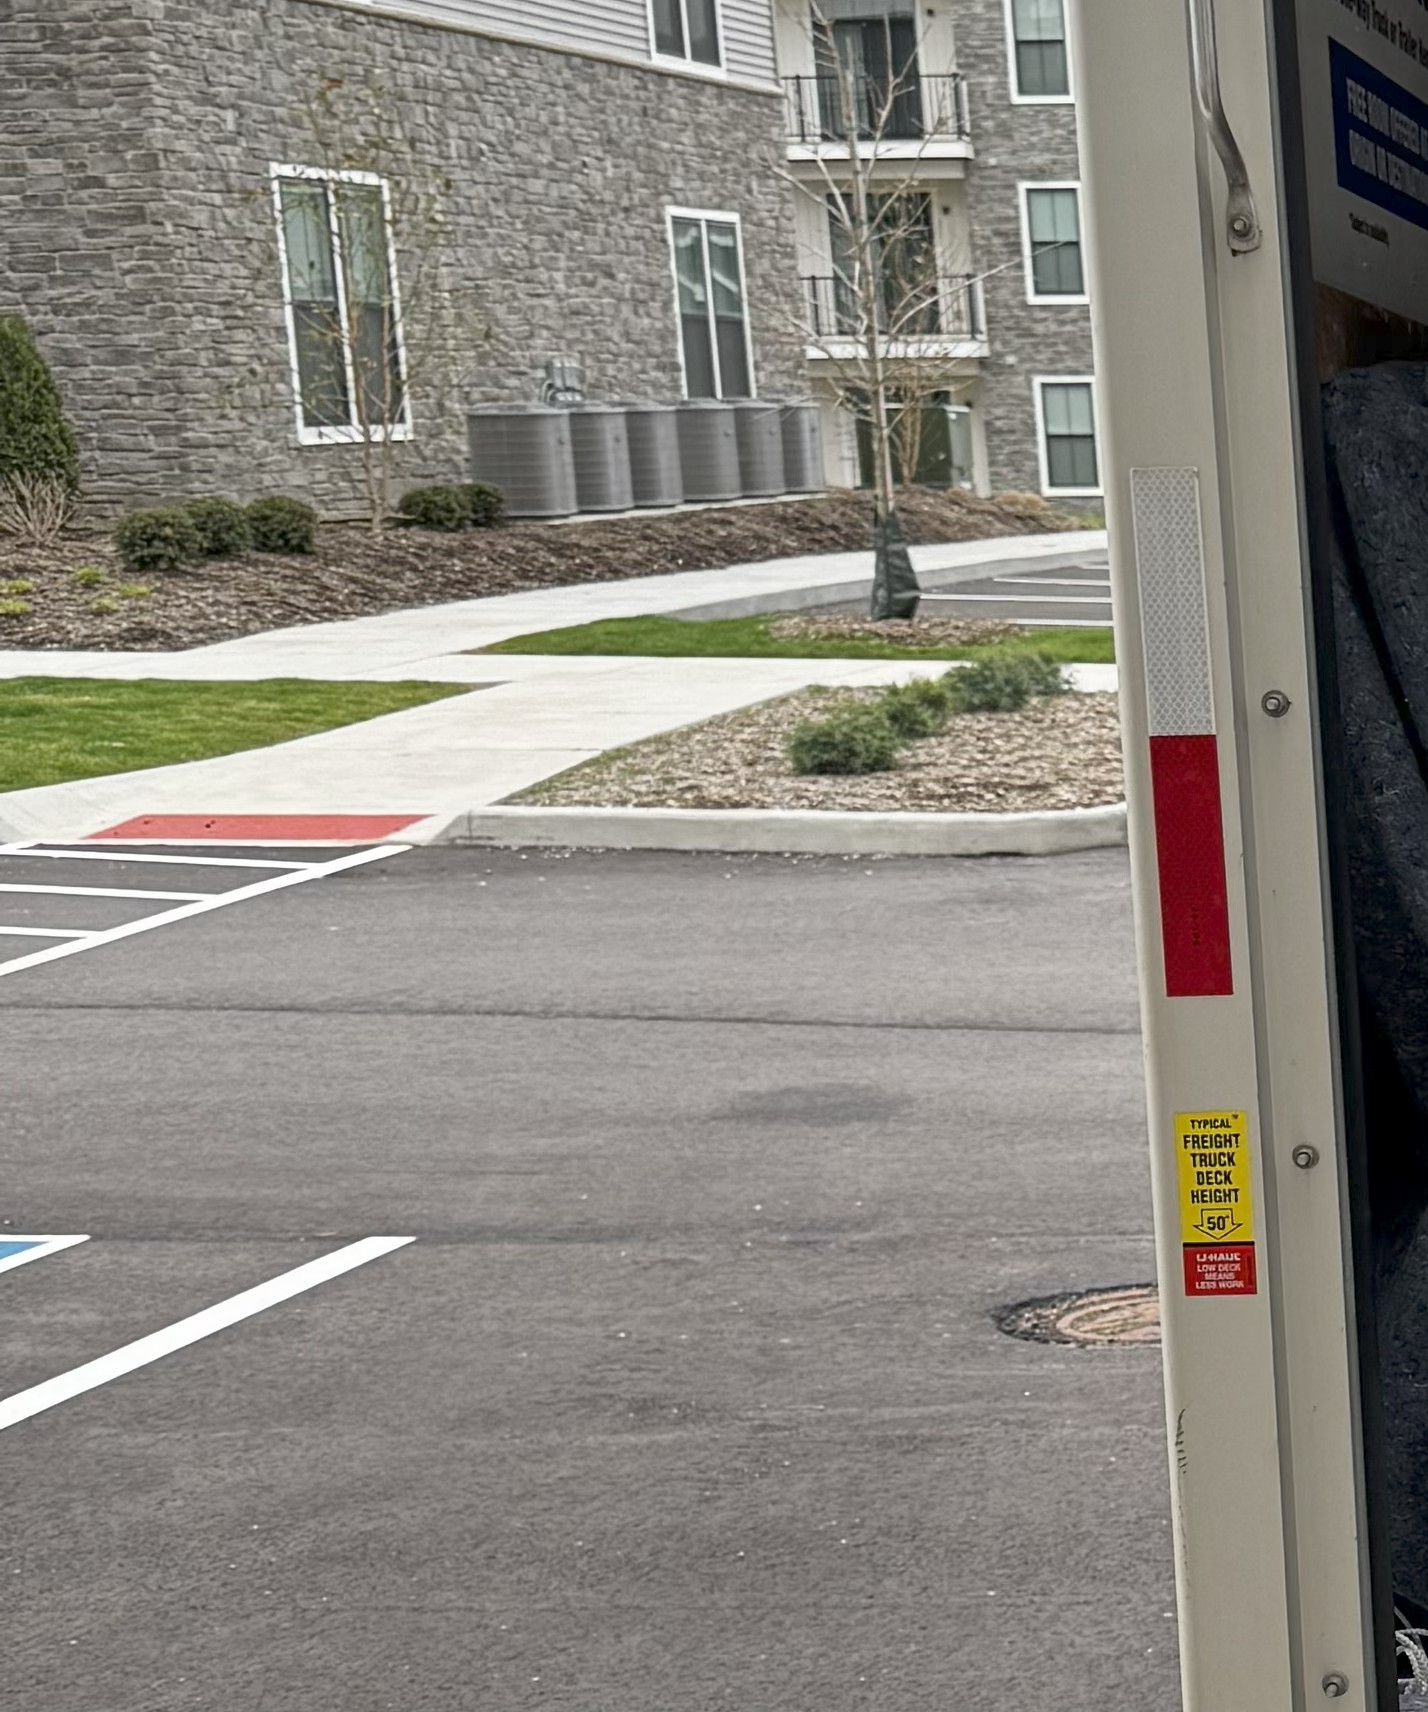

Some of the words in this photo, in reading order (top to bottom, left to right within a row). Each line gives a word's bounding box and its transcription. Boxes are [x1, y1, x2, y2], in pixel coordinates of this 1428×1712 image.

[1190, 1118, 1231, 1129] TYPICAL
[1184, 1133, 1240, 1150] FREIGHT
[1190, 1152, 1235, 1168] TRUCK
[1196, 1170, 1233, 1185] DECK
[1191, 1189, 1240, 1204] HEIGHT
